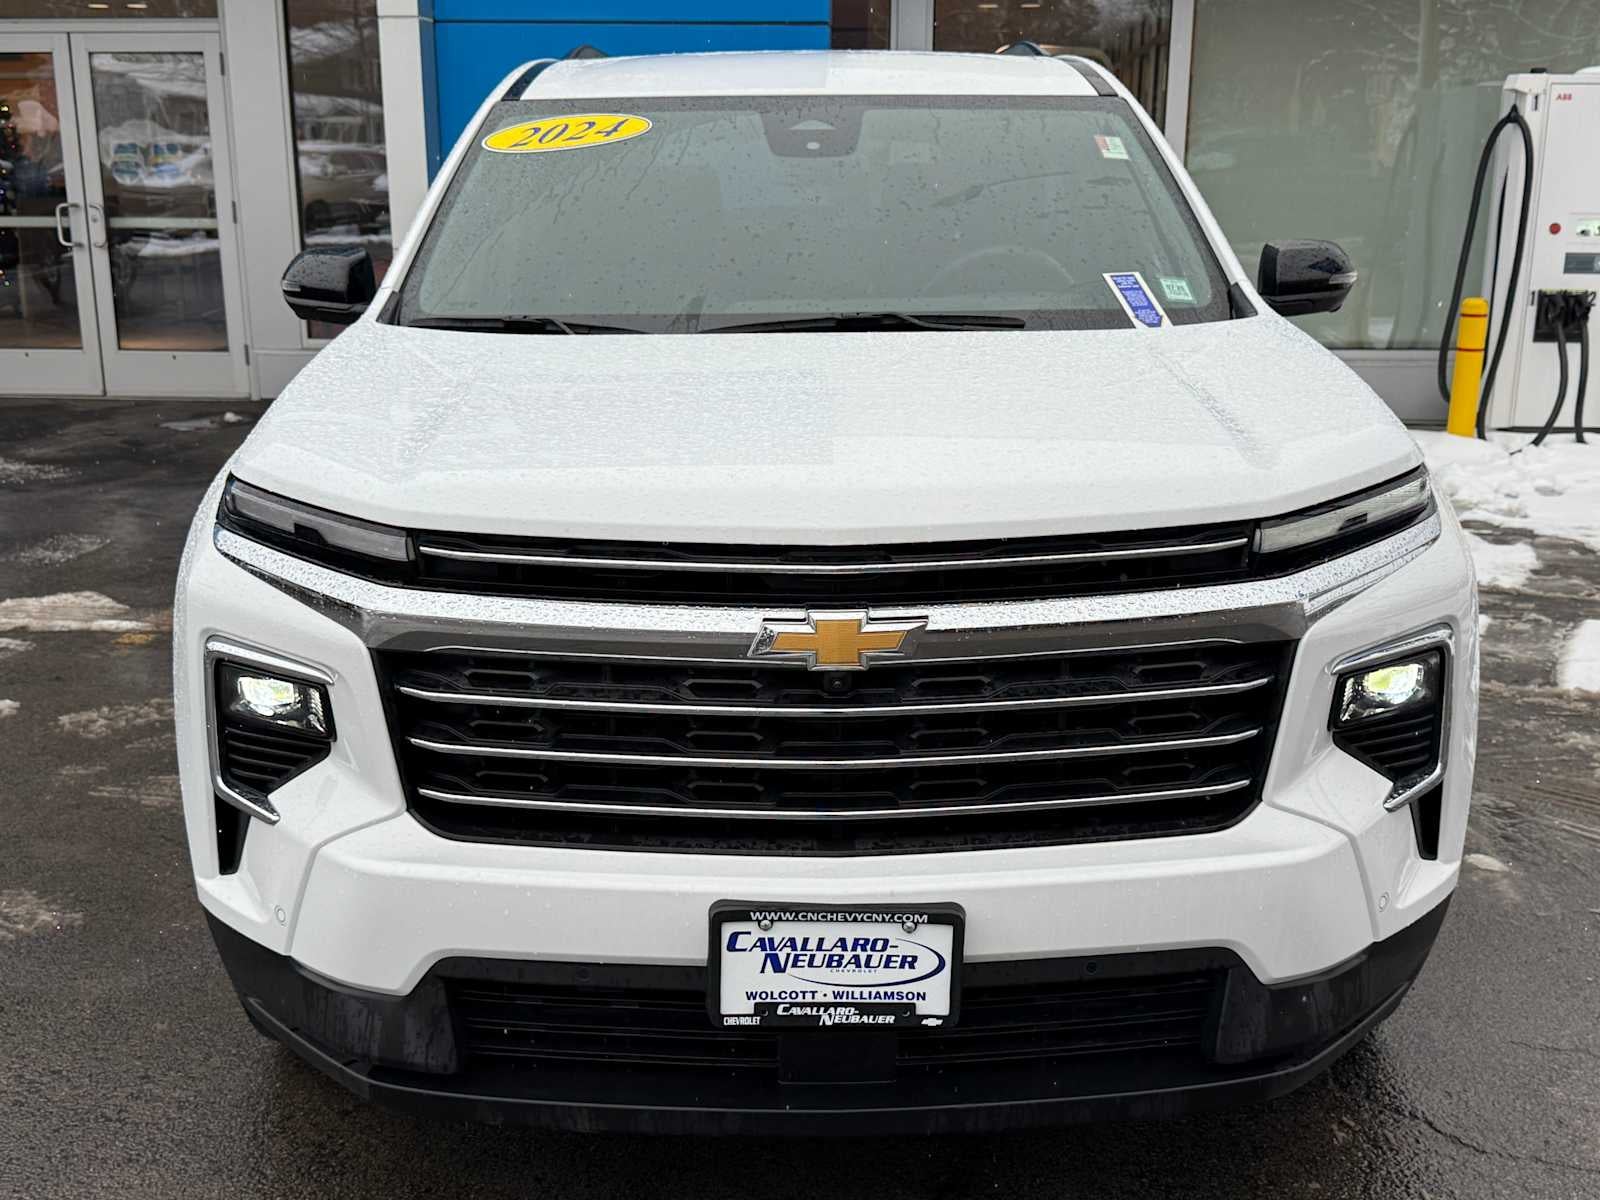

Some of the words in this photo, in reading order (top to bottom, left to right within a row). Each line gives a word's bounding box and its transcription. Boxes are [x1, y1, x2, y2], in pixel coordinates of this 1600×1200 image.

[507, 118, 630, 148] 2024
[750, 911, 928, 924] WWW.CNCHEVYCNY.COM
[726, 931, 899, 952] CAVALLARO-
[759, 953, 918, 974] NEUBAUER
[745, 990, 818, 1001] WOLCOTT
[832, 990, 927, 1001] WILLIAMSON
[776, 1004, 859, 1016] CAVALLARO-
[723, 1016, 762, 1026] CHEVROLET
[819, 1014, 896, 1026] NEUBAUER
